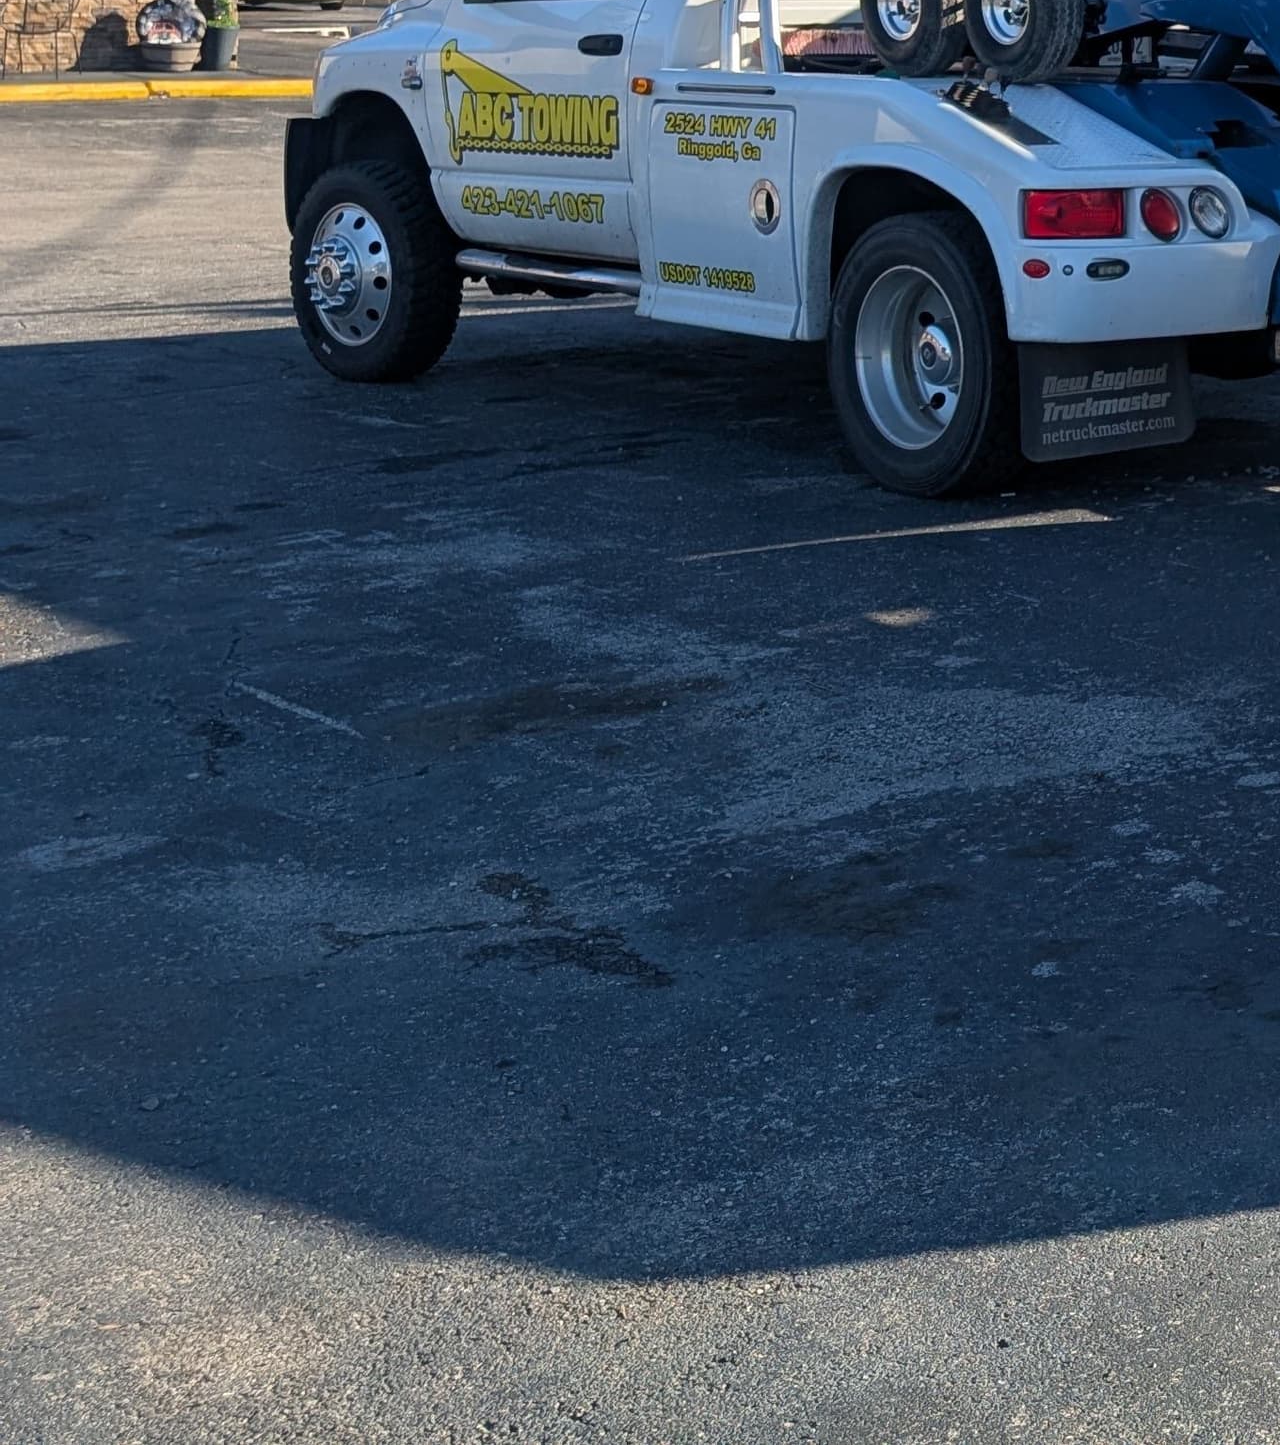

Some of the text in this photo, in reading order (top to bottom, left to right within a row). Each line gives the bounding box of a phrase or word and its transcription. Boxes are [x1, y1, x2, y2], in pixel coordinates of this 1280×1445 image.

[457, 91, 620, 149] ABC TOWING
[664, 111, 777, 140] 2524 HWY 41
[677, 137, 761, 162] Ringgold, Ga
[461, 184, 605, 224] 423-421-1067
[659, 262, 756, 293] USDOT 1419528
[1042, 362, 1168, 395] New England
[1042, 391, 1172, 423] Truckmaster
[1042, 414, 1176, 445] netruckmaster.com
